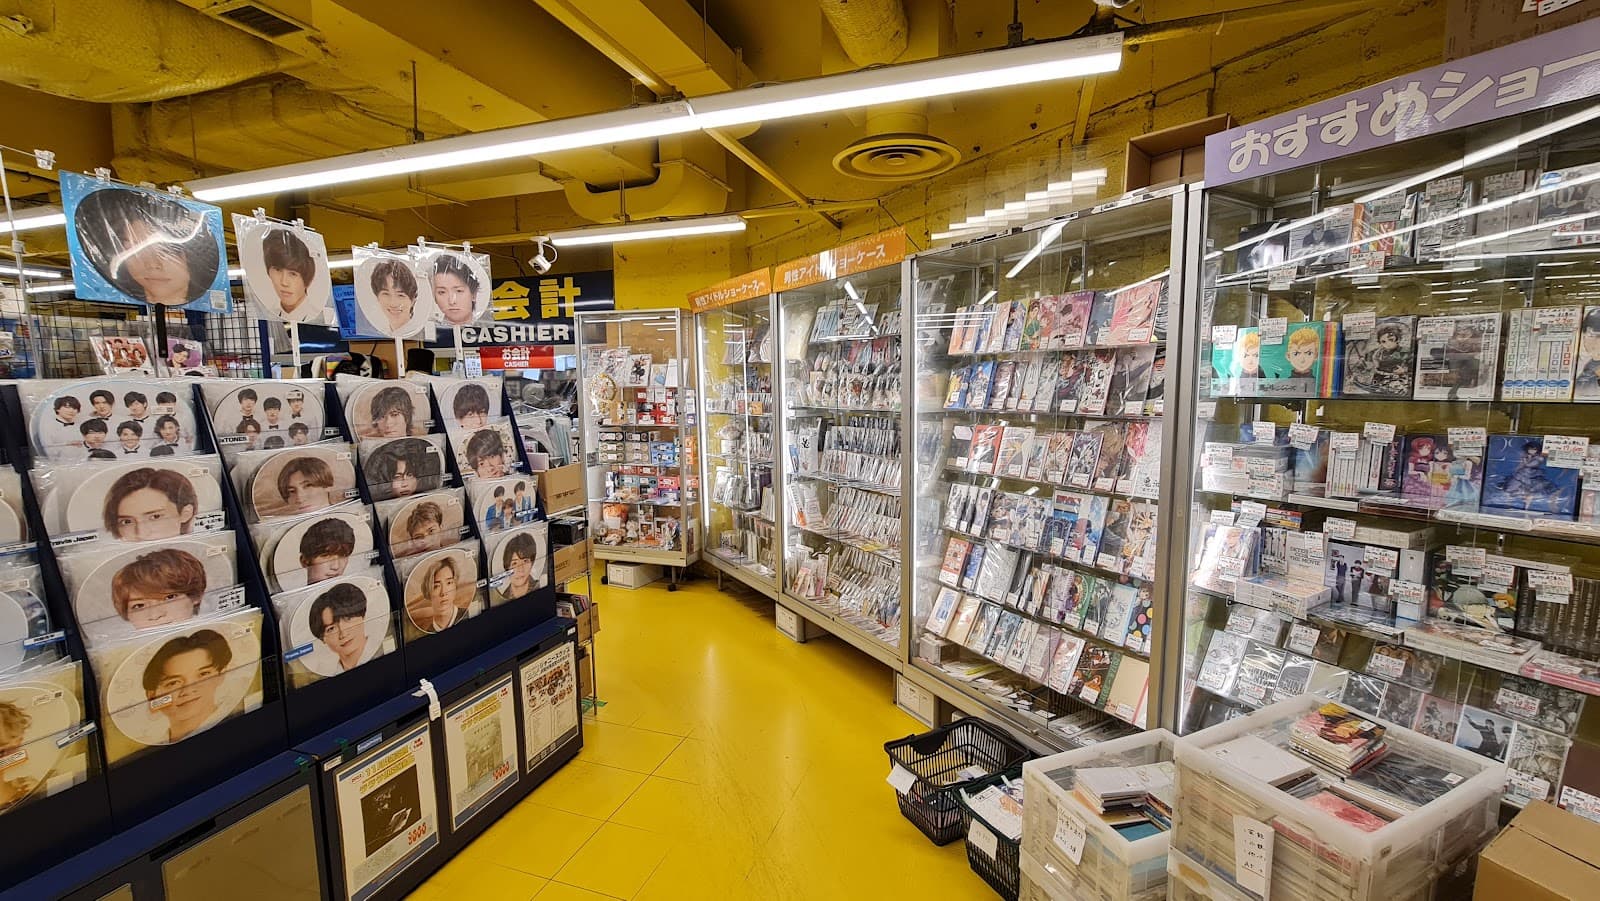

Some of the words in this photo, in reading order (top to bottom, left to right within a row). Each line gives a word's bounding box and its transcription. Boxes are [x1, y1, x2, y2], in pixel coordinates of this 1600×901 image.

[461, 324, 569, 344] CASHIER
[502, 347, 530, 360] お会計
